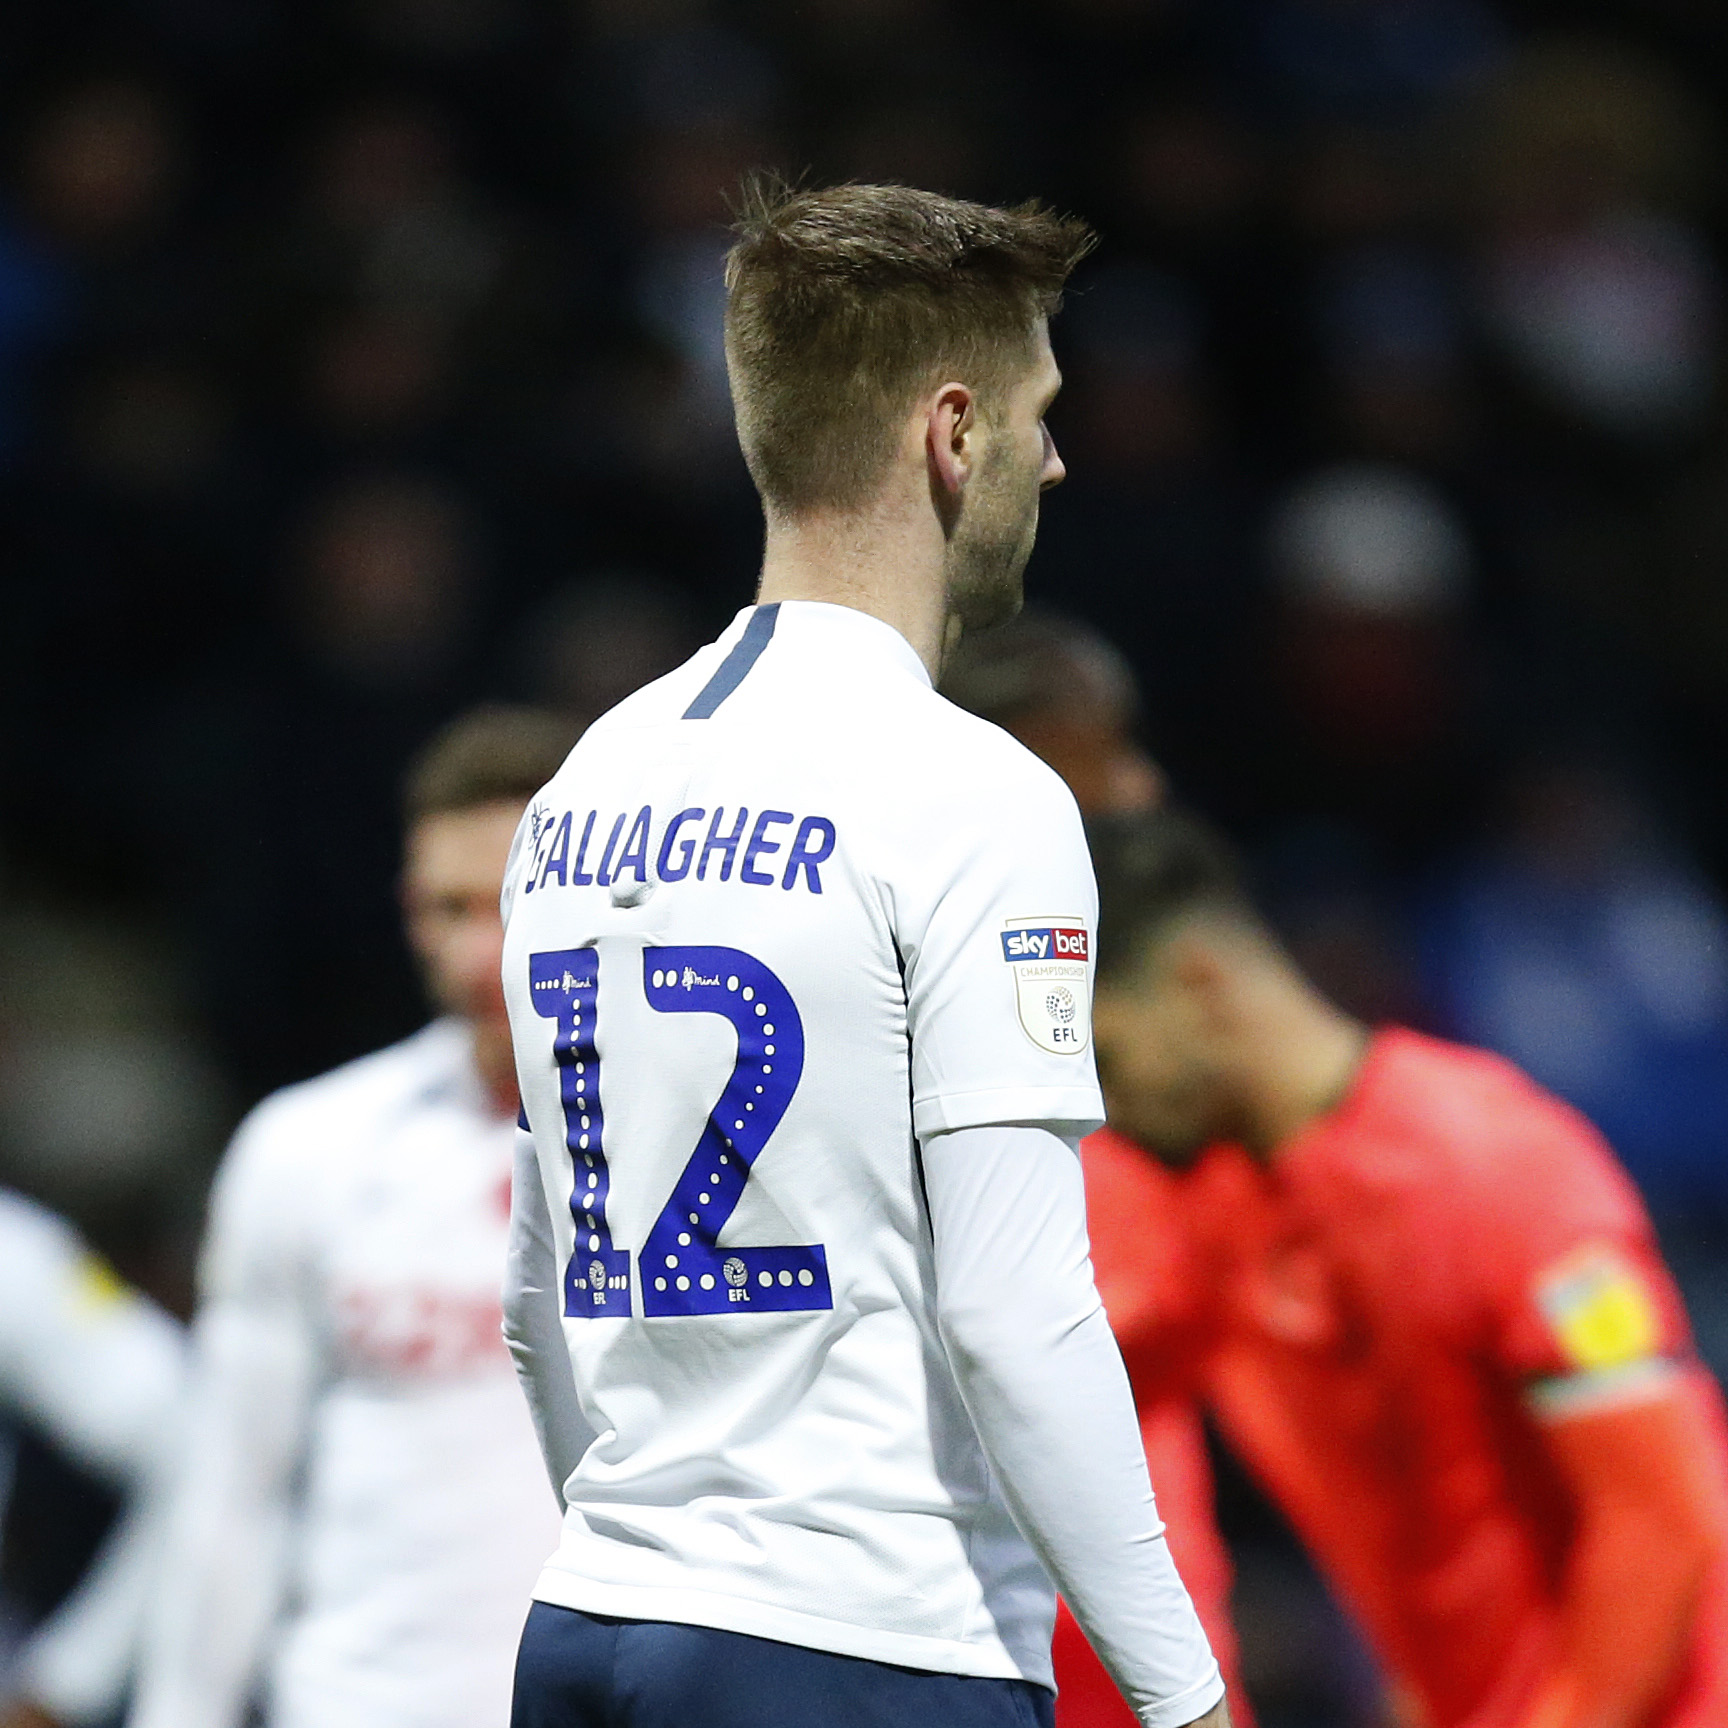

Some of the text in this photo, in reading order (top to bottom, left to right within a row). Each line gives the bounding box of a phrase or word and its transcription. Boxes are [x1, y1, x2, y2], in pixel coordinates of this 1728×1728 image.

[525, 804, 837, 895] GALLAGHER
[1007, 929, 1087, 958] sky bet
[1020, 965, 1085, 978] CHAMPIONSHIP
[1053, 1027, 1078, 1043] EFL
[529, 945, 834, 1319] 12
[728, 1288, 751, 1302] EFL
